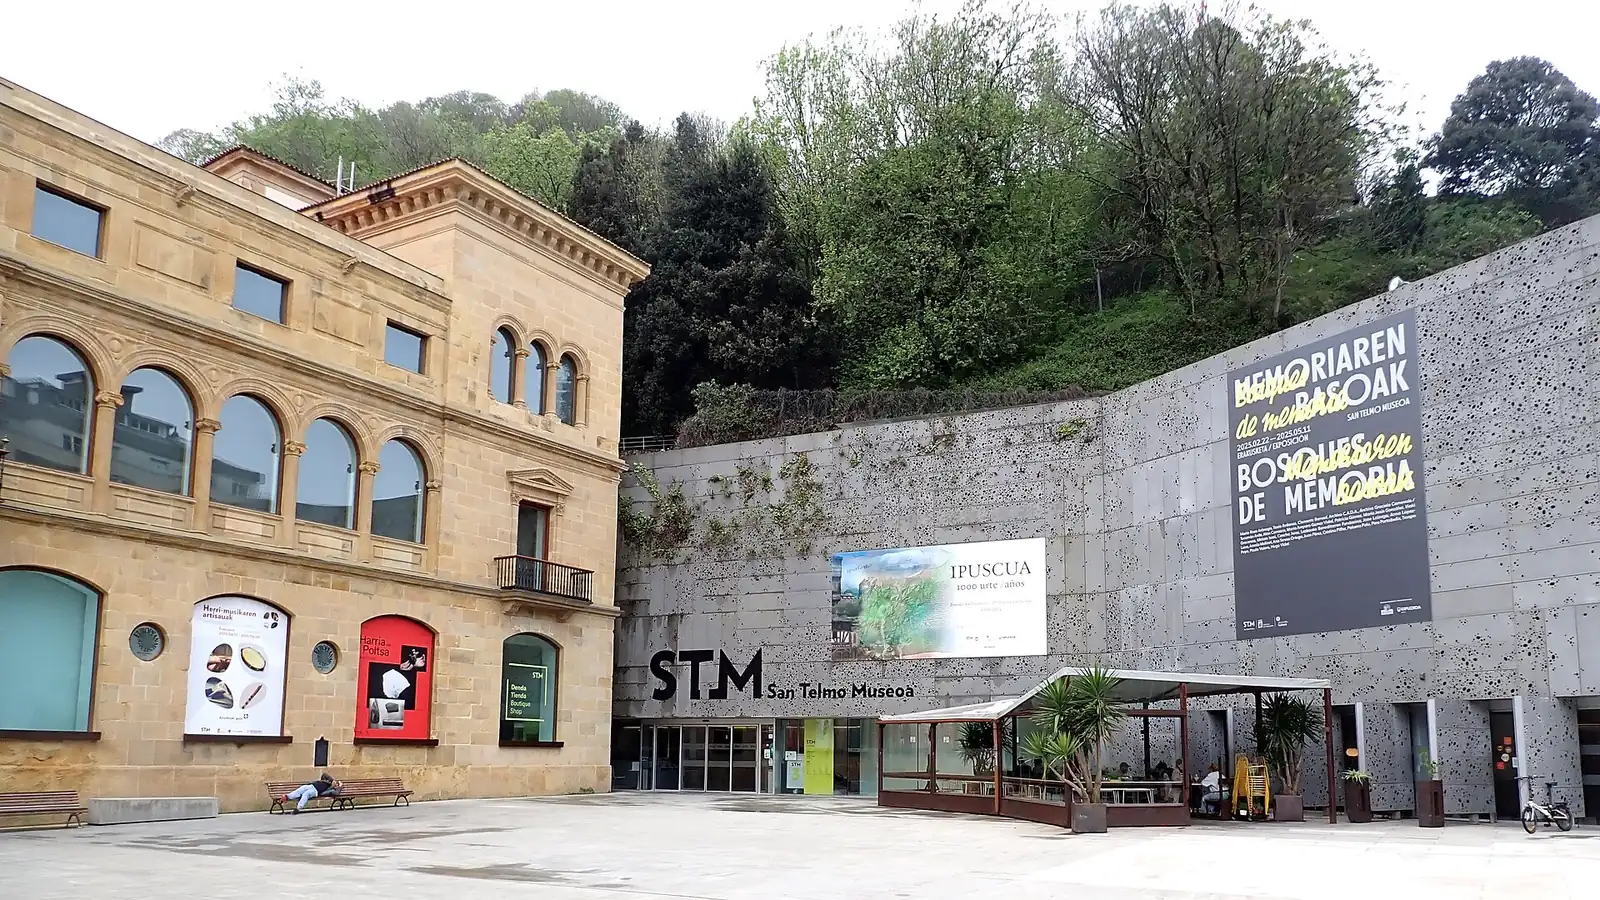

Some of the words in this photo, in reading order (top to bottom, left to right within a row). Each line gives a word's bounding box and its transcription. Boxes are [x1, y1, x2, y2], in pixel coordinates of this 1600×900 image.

[1347, 411, 1359, 421] SAN
[1360, 405, 1381, 418] TELMO
[1382, 397, 1410, 411] MUSEOA
[1236, 413, 1258, 440] de
[1237, 446, 1267, 459] ERAKUSKETA
[1238, 433, 1365, 492] BOSQUES
[1239, 492, 1266, 525] DE
[1284, 459, 1415, 516] MEMORIA
[950, 560, 1031, 579] IPUSCUA
[980, 582, 998, 590] urte
[1005, 580, 1025, 588] años
[203, 604, 257, 617] Herri-musikaren
[203, 612, 233, 621] artisauak
[360, 635, 386, 647] Harria
[362, 644, 390, 656] Poltsa
[650, 648, 763, 700] STM
[767, 682, 795, 699] San
[799, 682, 847, 699] Telmo
[852, 682, 915, 698] Museoa
[510, 700, 531, 708] Boutique
[510, 708, 523, 716] Shop
